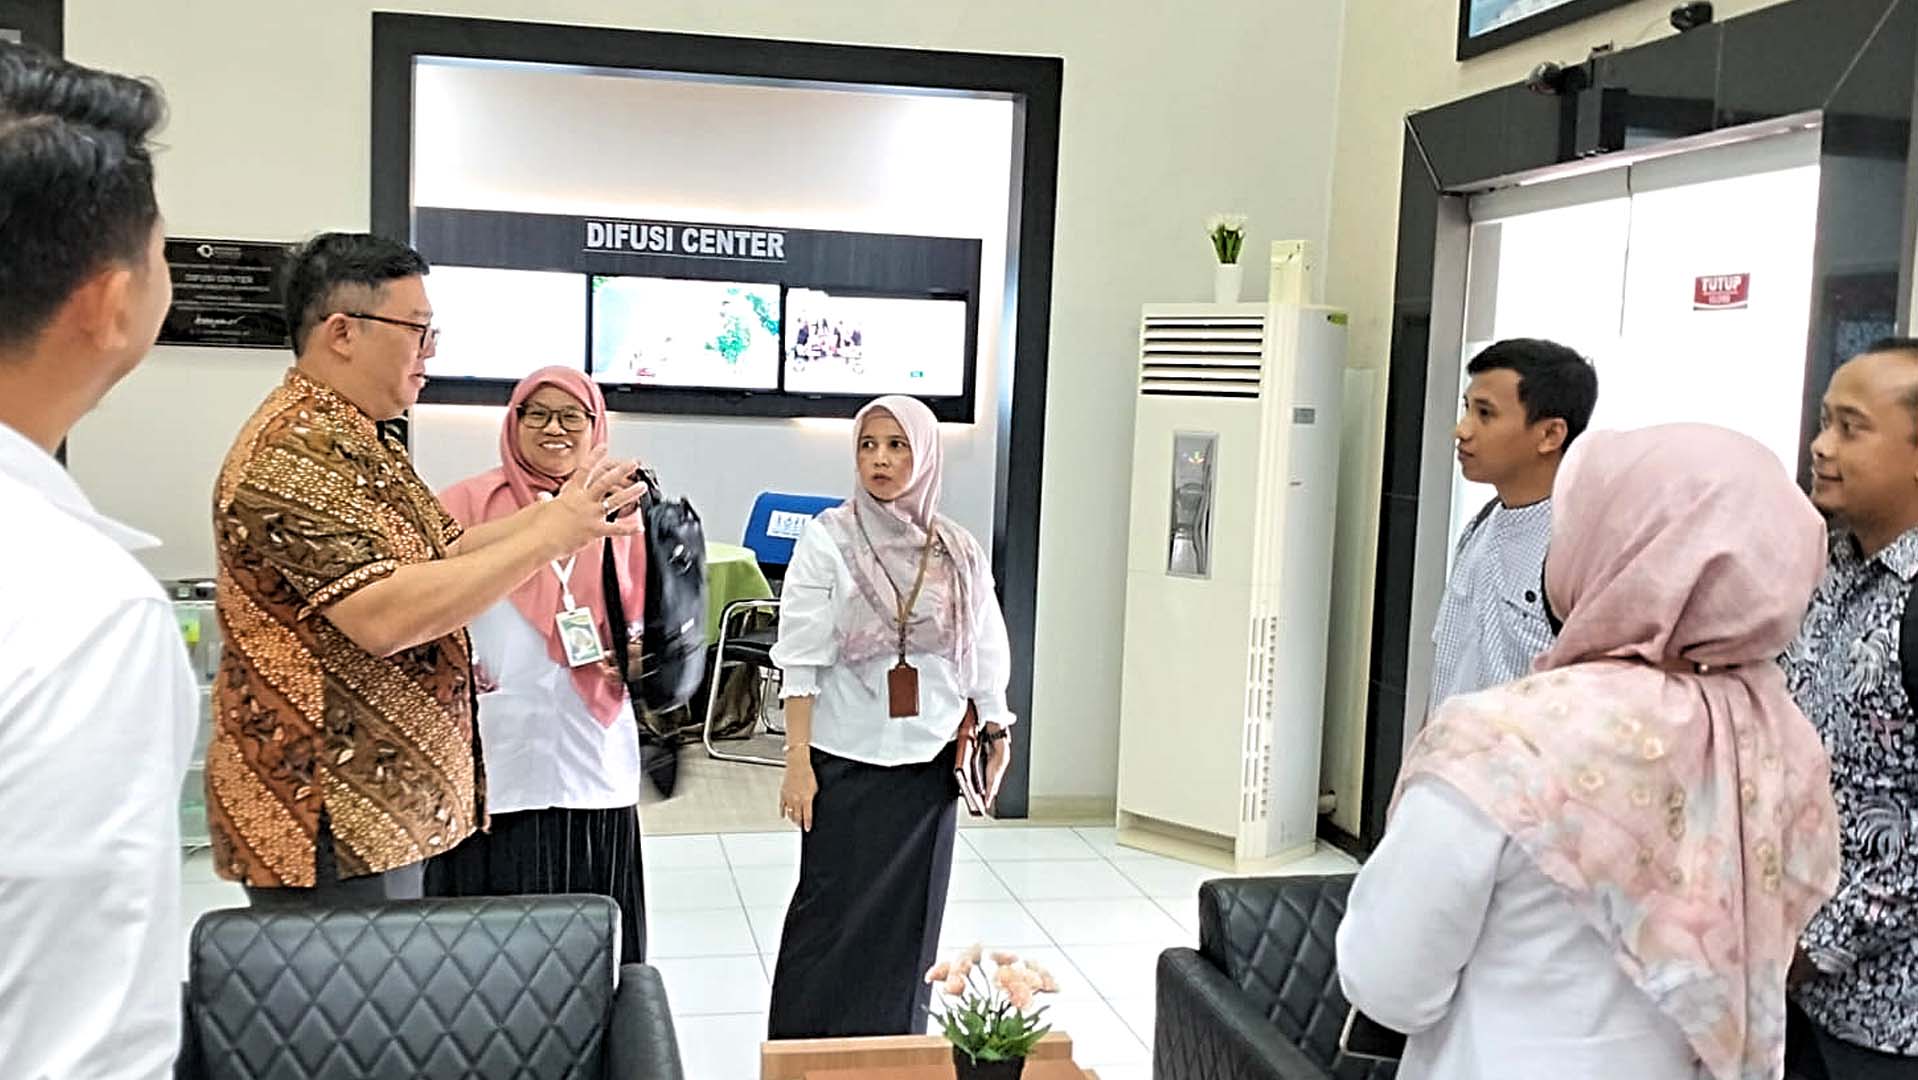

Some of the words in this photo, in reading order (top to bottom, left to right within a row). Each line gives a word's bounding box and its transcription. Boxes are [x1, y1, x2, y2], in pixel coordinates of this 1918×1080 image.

[587, 222, 673, 251] DIFUSI
[681, 228, 785, 258] CENTER
[1701, 275, 1742, 292] TUTUP
